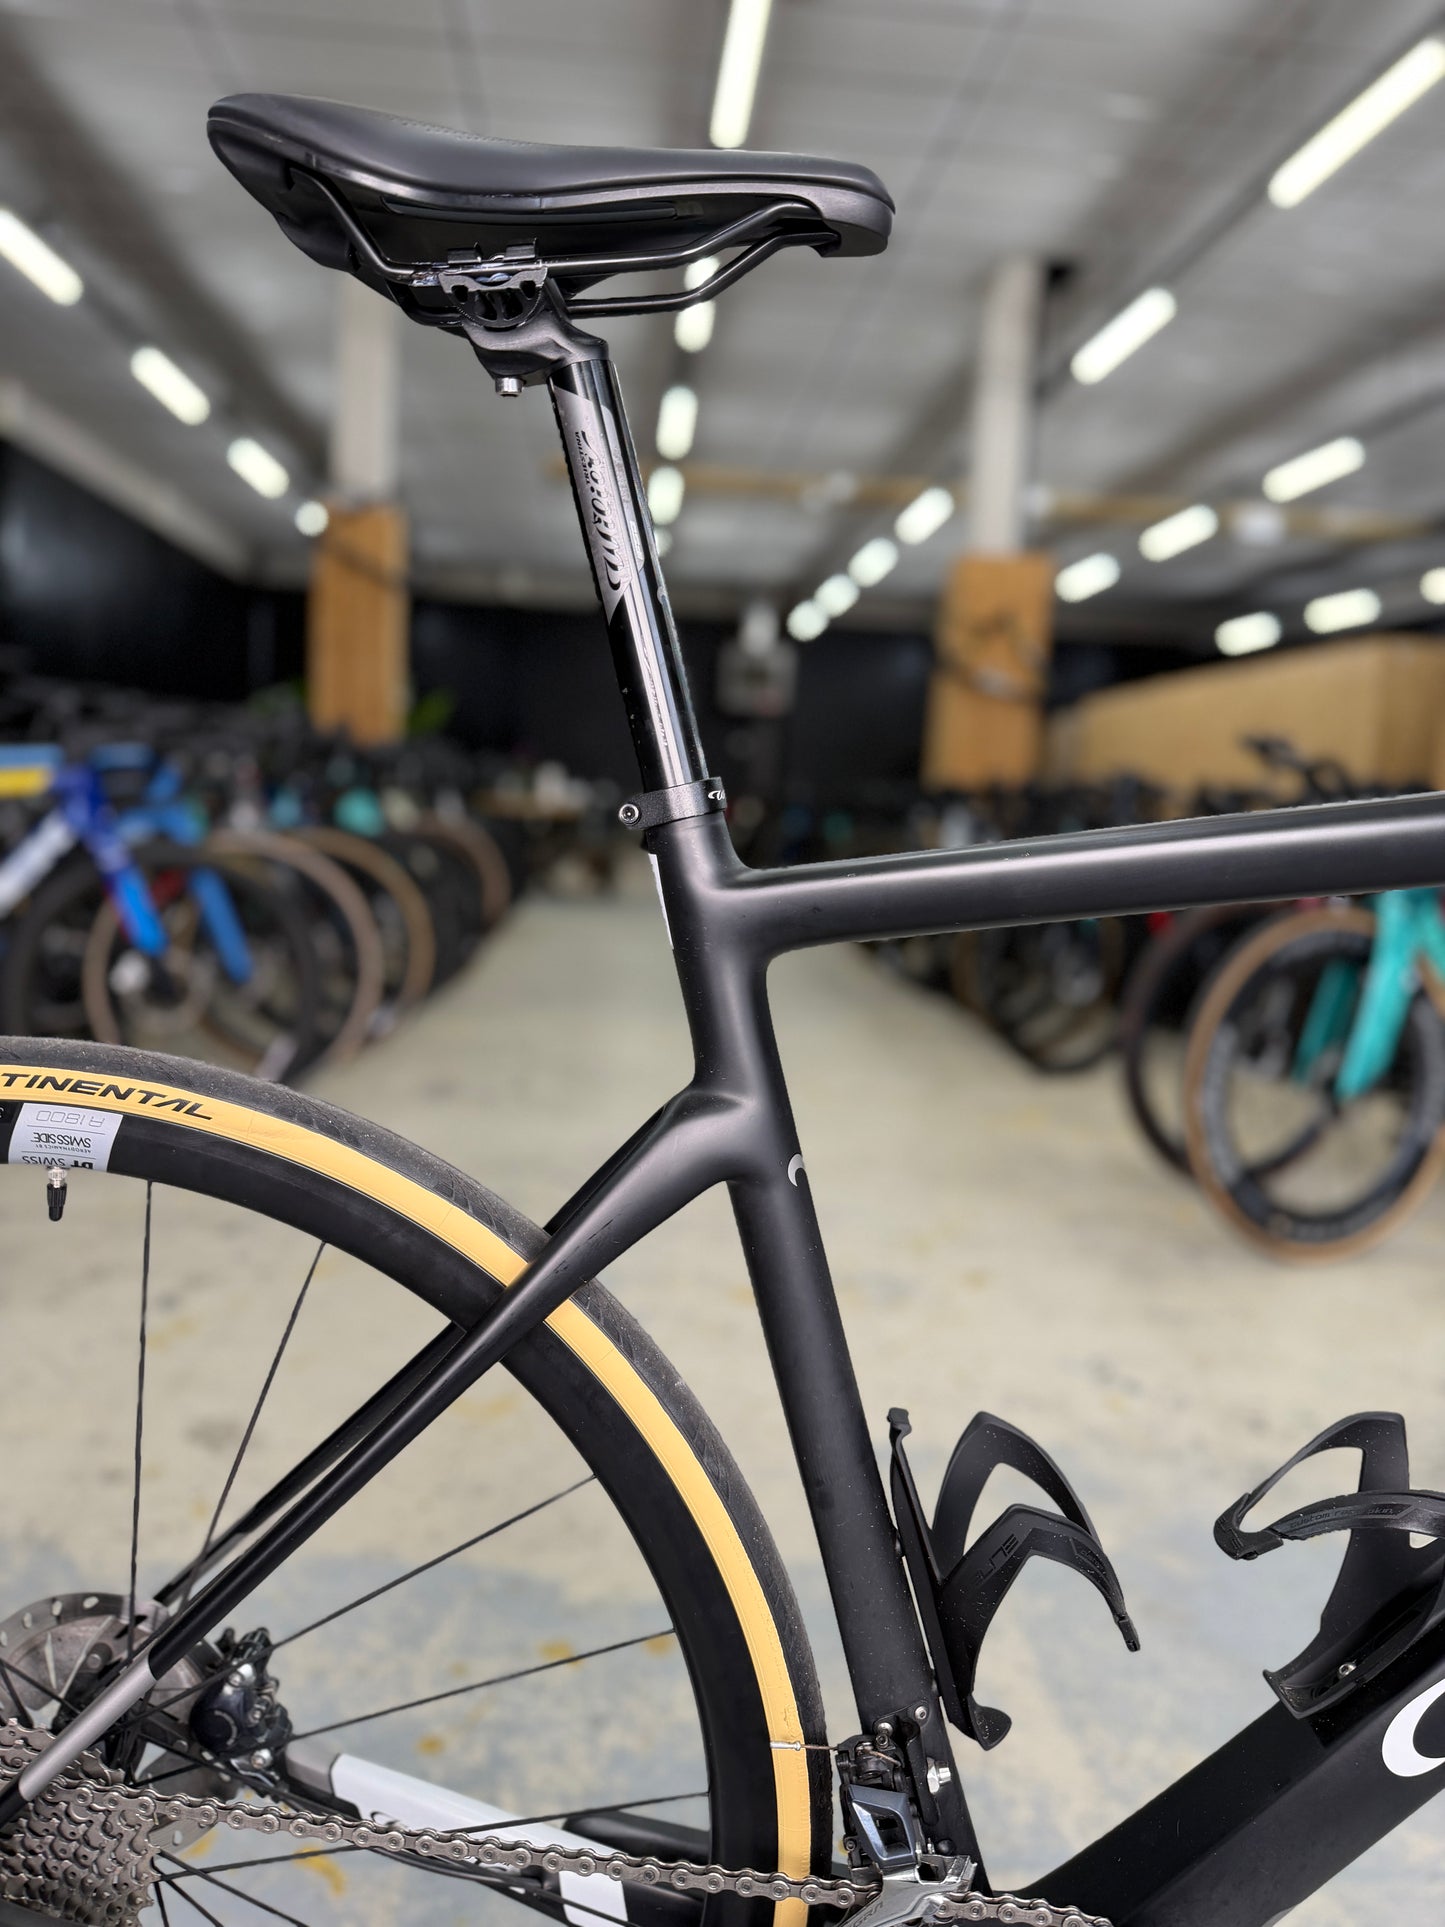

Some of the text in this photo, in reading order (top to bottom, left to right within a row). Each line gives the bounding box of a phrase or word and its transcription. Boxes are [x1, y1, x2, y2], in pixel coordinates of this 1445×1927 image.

[574, 431, 591, 486] TRIESTINA
[1, 1072, 213, 1121] TINENTAL
[21, 1155, 65, 1167] SWISS
